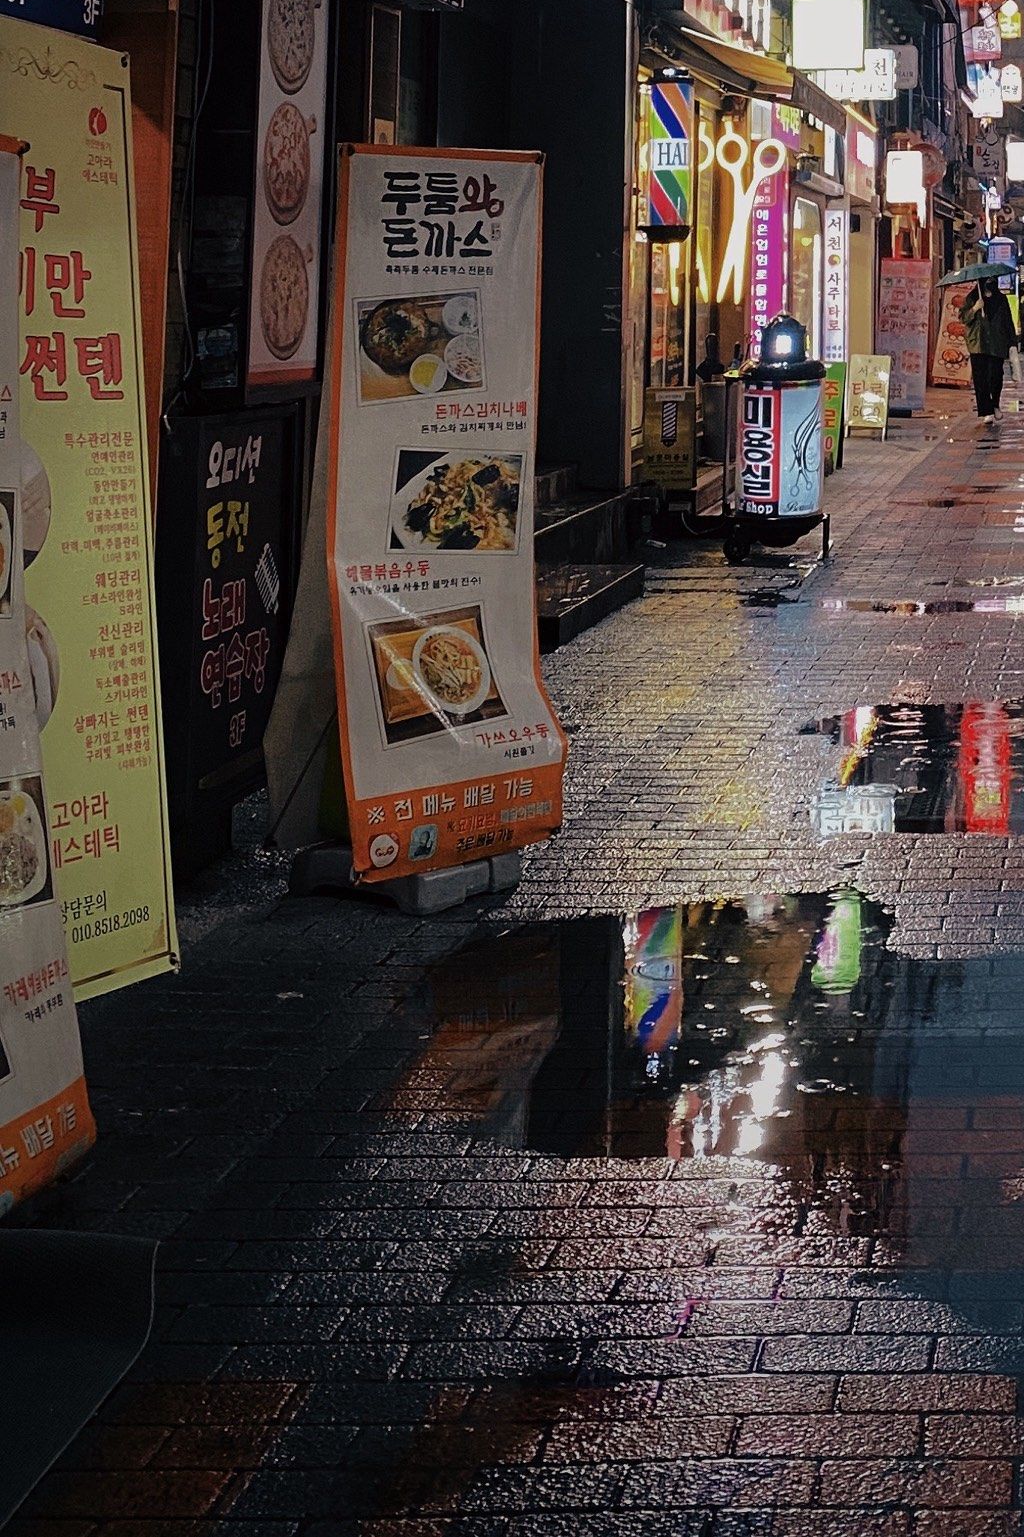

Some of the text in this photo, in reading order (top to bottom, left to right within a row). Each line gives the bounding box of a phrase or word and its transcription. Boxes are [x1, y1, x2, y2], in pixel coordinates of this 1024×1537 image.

[381, 218, 493, 258] 돈까스
[435, 400, 528, 420] 돈까스김치나베
[206, 435, 263, 489] 오디션
[741, 393, 775, 499] 미용실
[206, 500, 251, 569] 동전
[95, 568, 141, 589] 웨딩관리
[202, 576, 247, 642] 노래
[98, 619, 144, 643] 전신관리
[200, 627, 271, 710] 연습장
[51, 790, 110, 830] 고아라
[394, 776, 535, 821] 전 메뉴 배달 가능
[71, 904, 151, 946] 010.8518.2098
